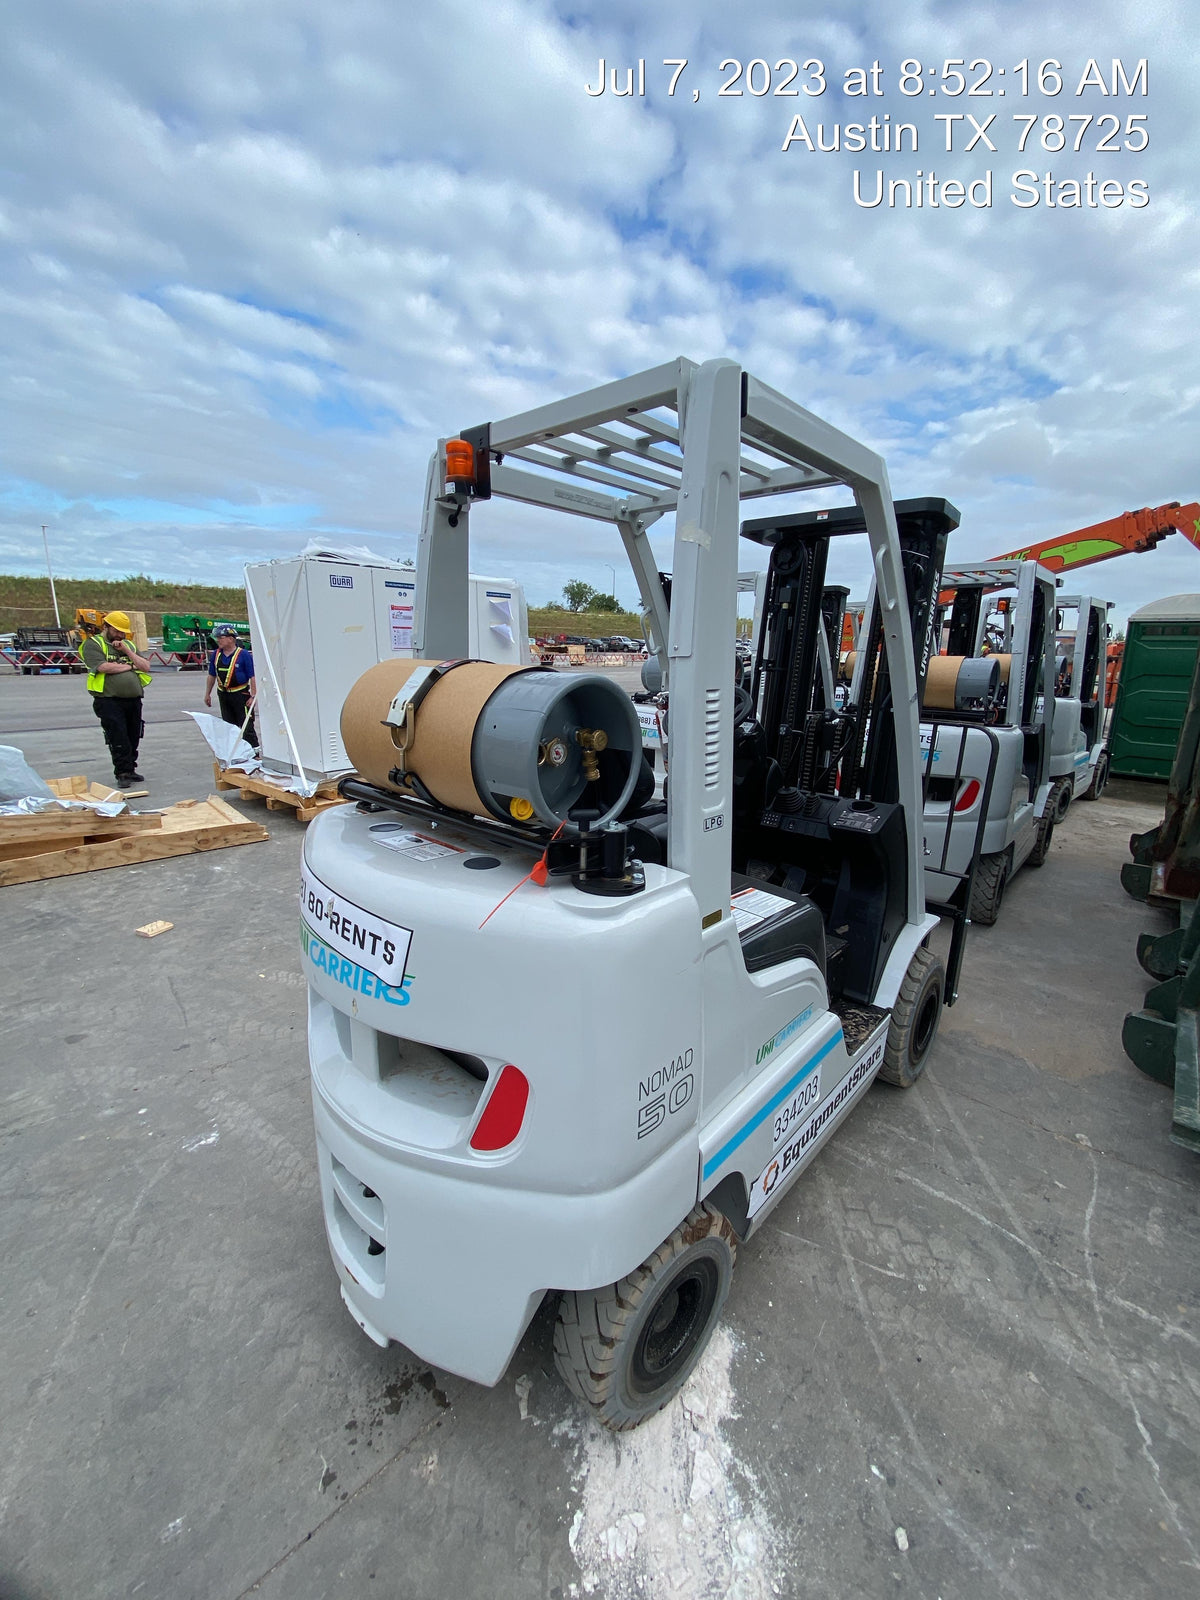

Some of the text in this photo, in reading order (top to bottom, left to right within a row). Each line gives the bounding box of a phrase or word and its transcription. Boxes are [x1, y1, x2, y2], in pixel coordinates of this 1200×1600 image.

[704, 816, 723, 830] LPG
[637, 1073, 694, 1140] 50
[638, 1047, 694, 1102] NOMAD
[781, 1044, 882, 1172] EquipmentShare
[773, 1074, 819, 1143] 334203
